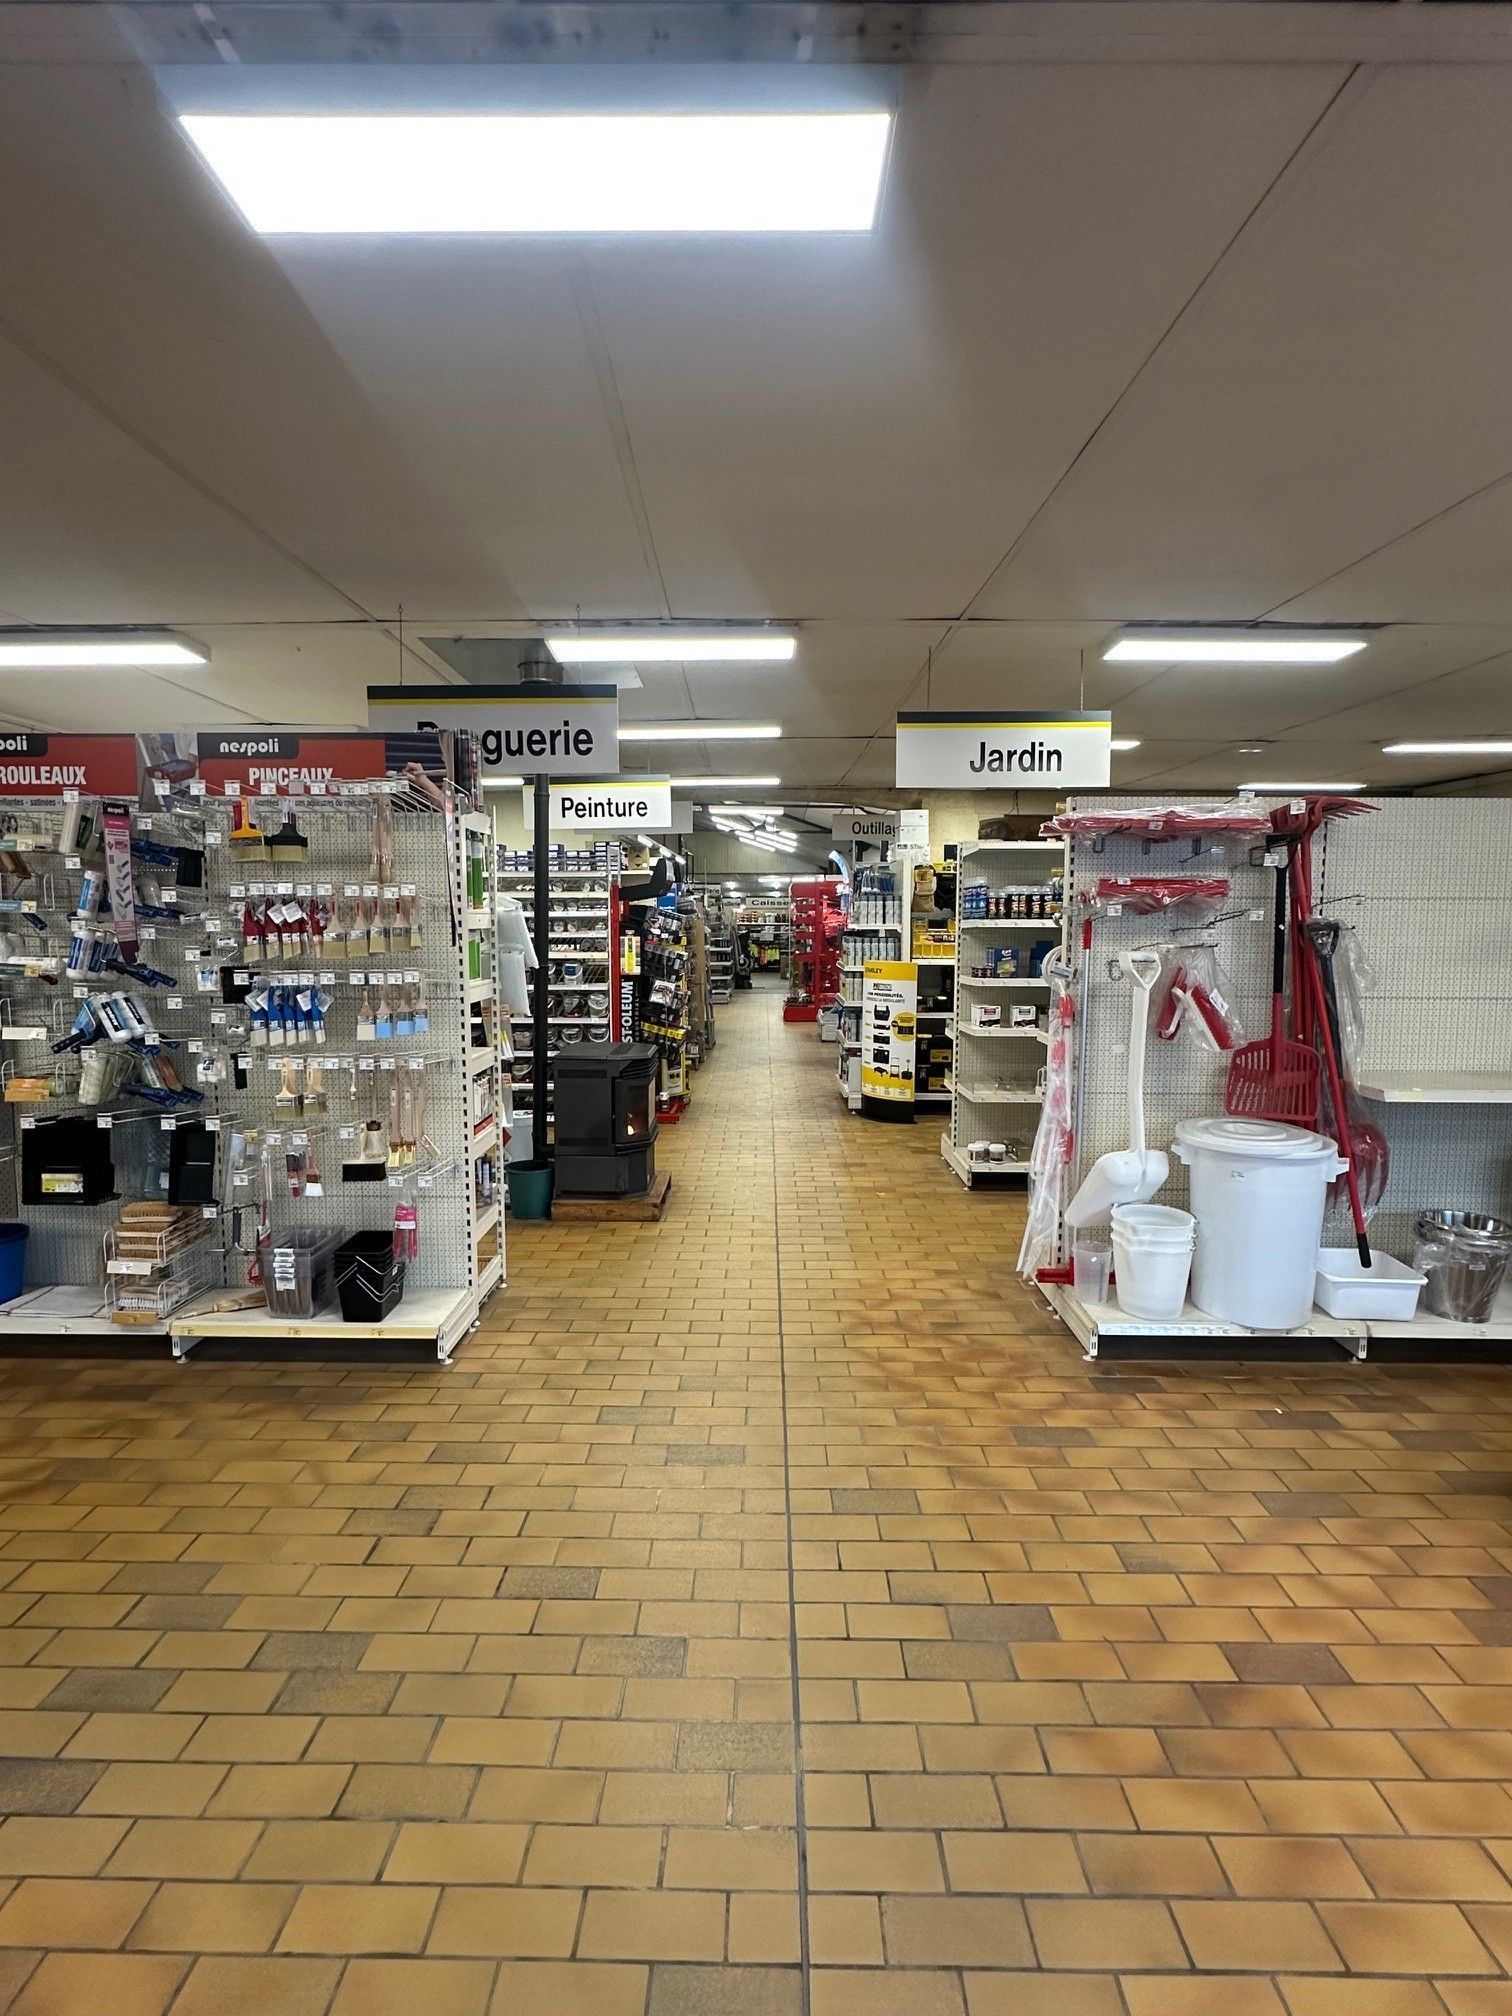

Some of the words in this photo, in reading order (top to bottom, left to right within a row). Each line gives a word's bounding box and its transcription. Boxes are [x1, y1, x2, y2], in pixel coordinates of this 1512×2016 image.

[219, 737, 279, 756] nespoli
[417, 720, 594, 766] guerie
[969, 741, 1062, 773] Jardin
[0, 765, 87, 785] ROULEAUX
[248, 767, 334, 786] PINCEAUX
[560, 797, 649, 819] Peinture
[621, 980, 634, 1043] ST-OLEUM
